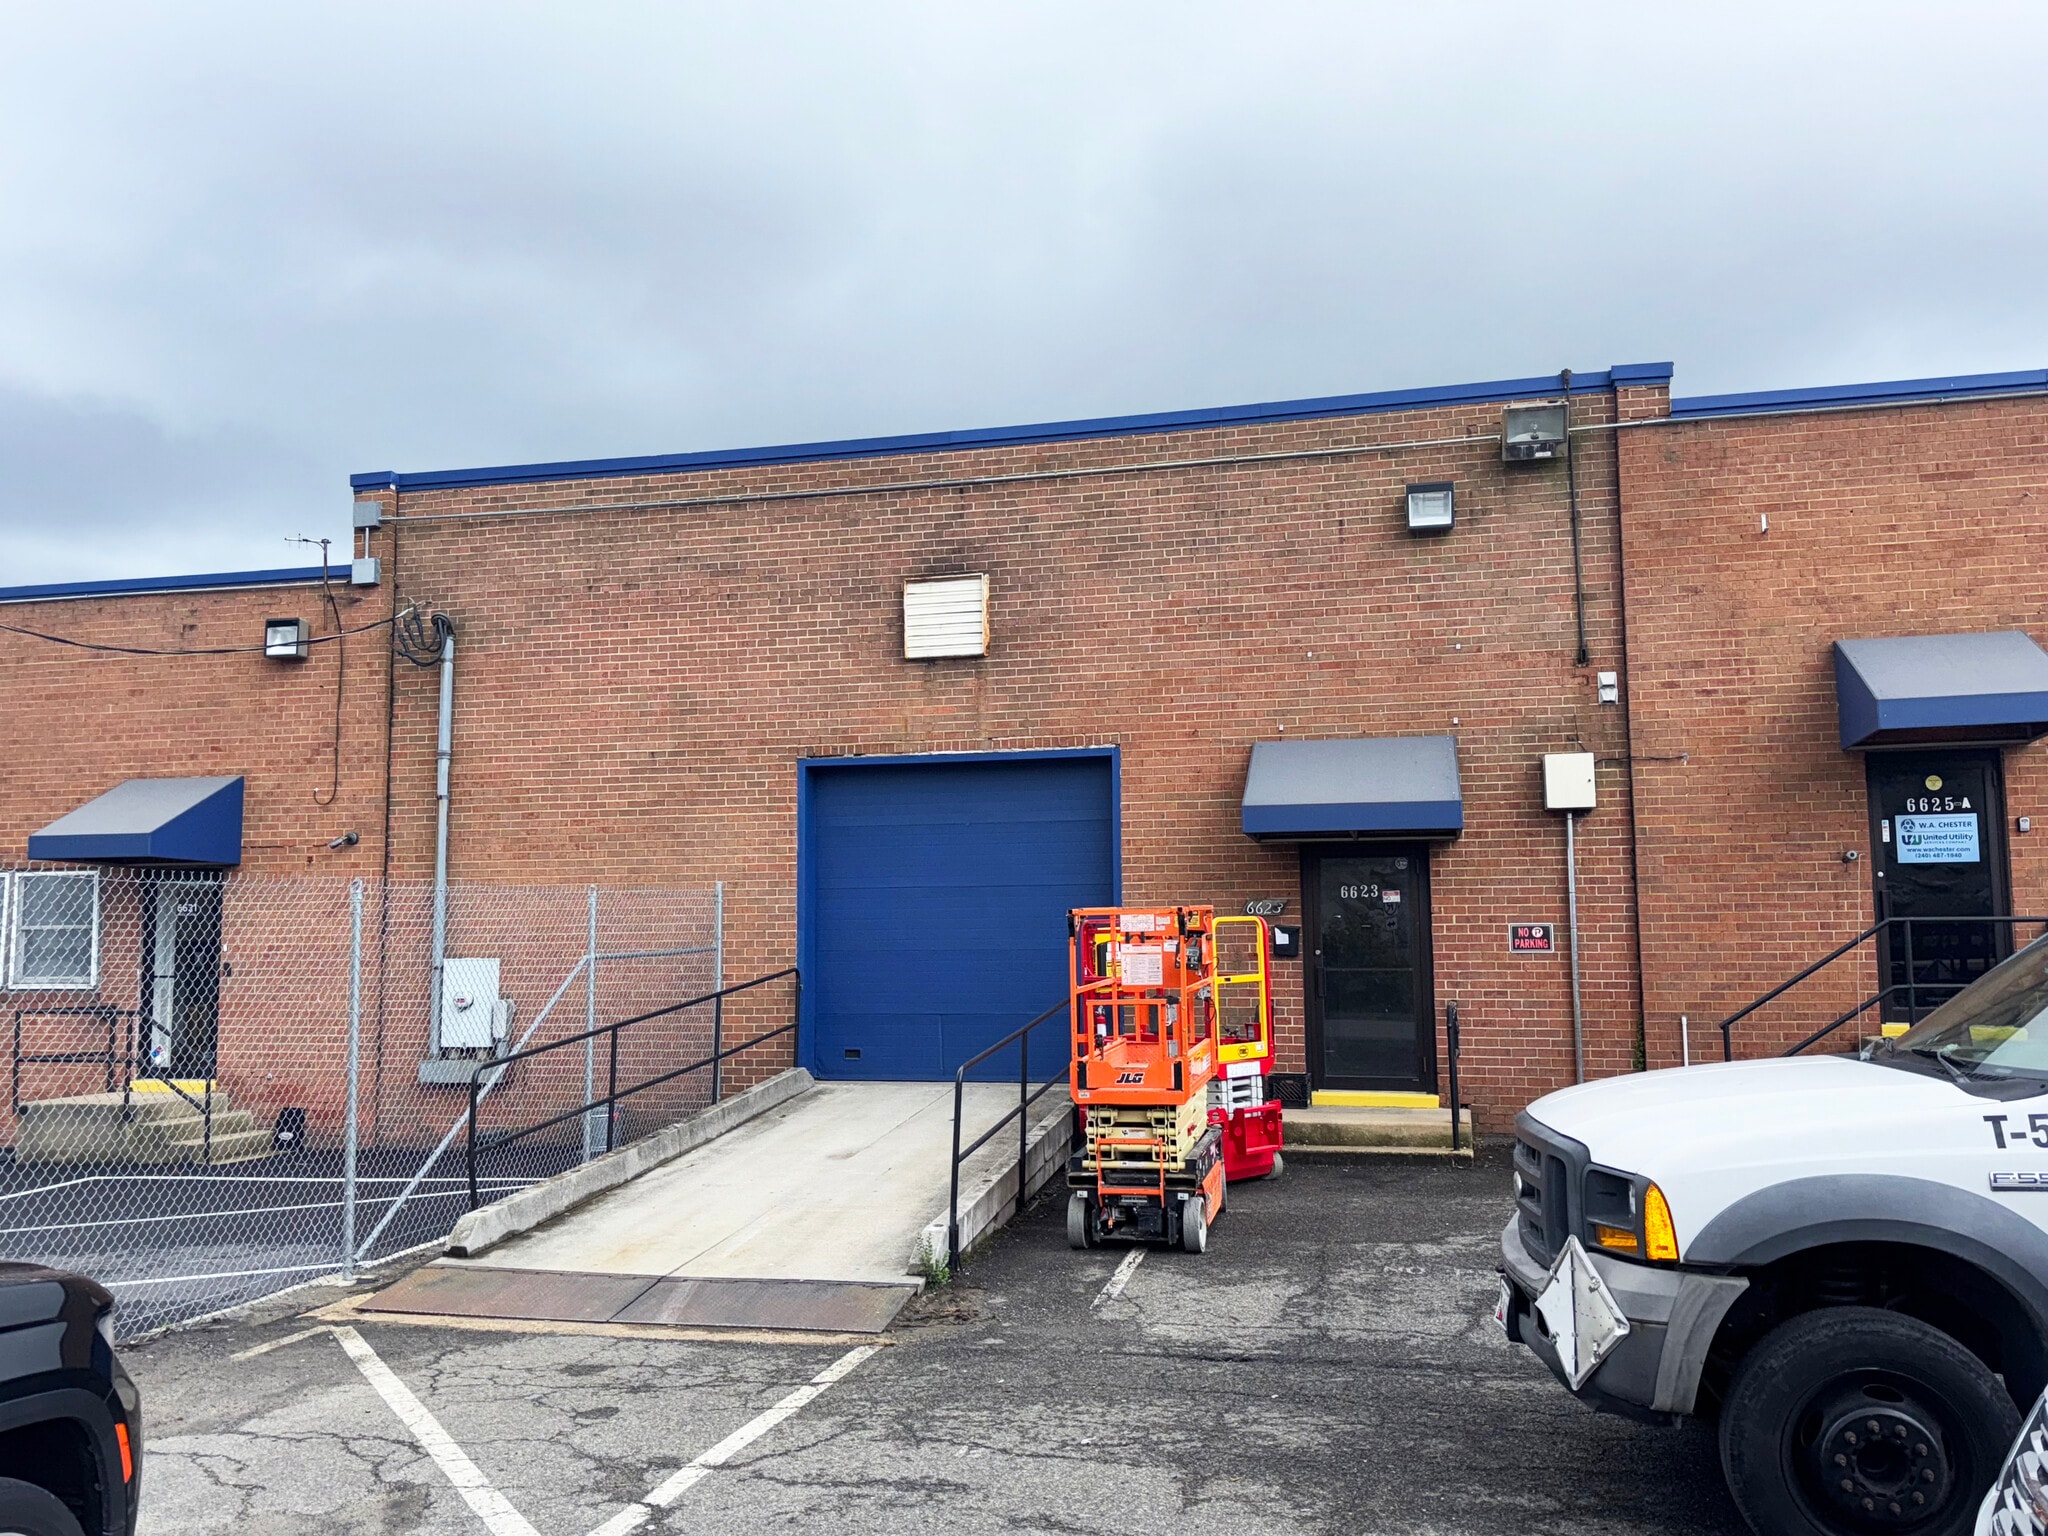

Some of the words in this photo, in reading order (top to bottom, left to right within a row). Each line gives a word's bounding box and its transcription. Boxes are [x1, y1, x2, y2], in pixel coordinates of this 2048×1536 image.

[1907, 797, 1971, 812] 6625-A
[1948, 833, 1973, 841] Utility
[1340, 884, 1379, 899] 6623
[1246, 901, 1284, 915] 6623
[1518, 928, 1529, 937] NO
[1514, 939, 1549, 948] PARKING
[1116, 1073, 1144, 1084] JLG
